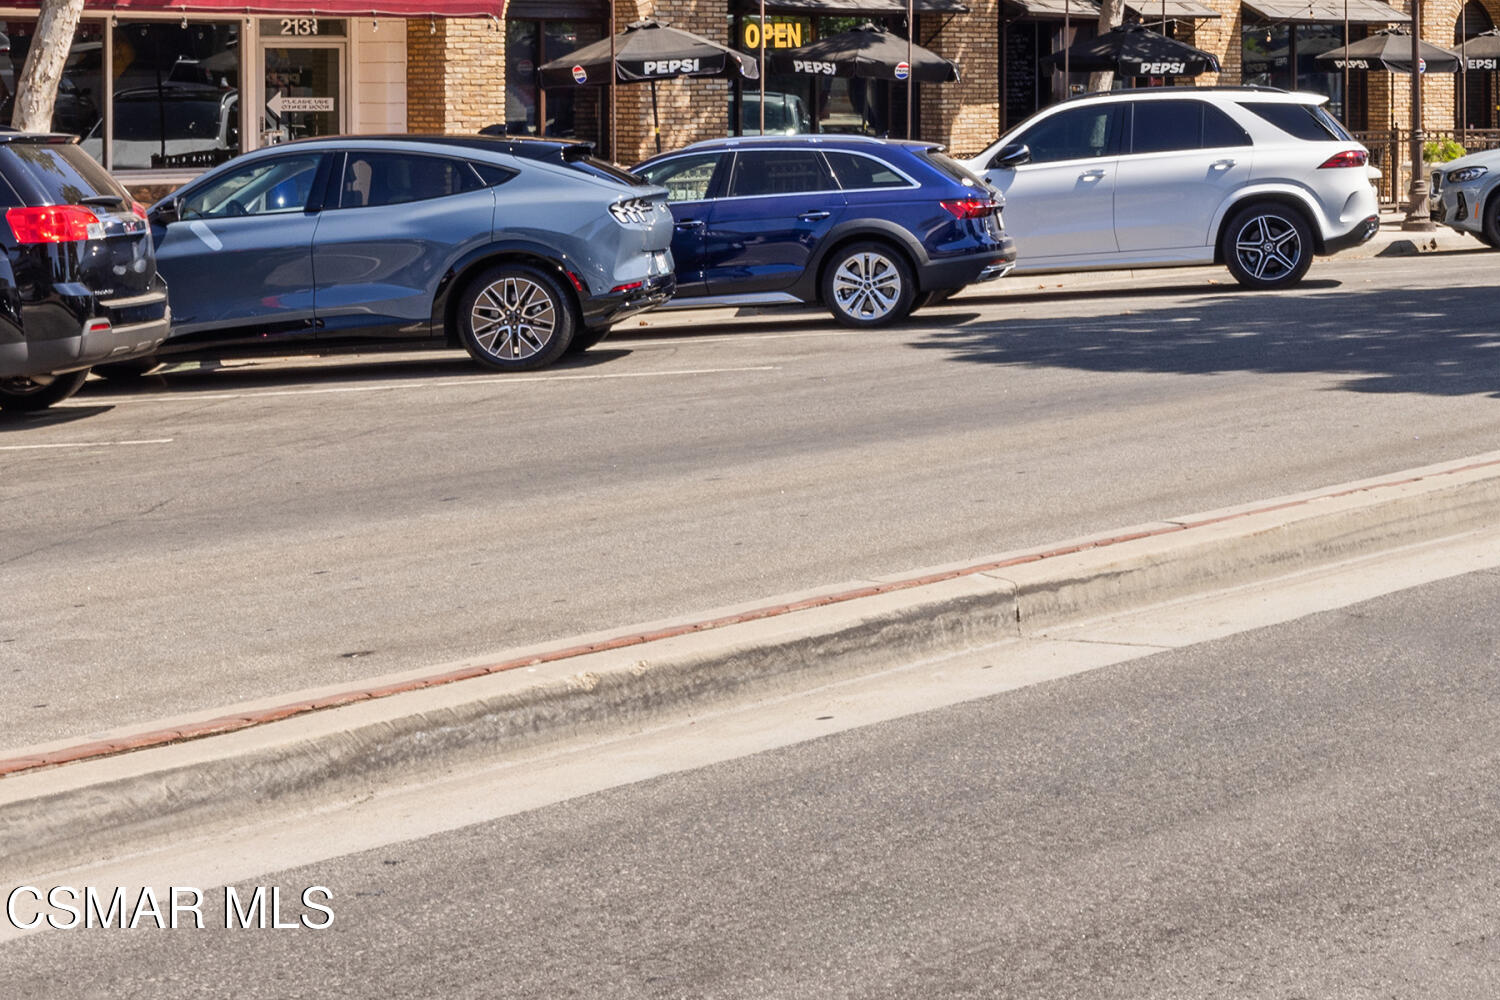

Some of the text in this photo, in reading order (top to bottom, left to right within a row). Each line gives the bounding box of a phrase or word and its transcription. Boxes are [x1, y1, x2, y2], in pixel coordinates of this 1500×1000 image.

[745, 23, 802, 49] OPEN
[643, 59, 698, 75] PEPSI
[793, 60, 836, 75] PEPSI
[1140, 62, 1185, 74] PEPSI
[1467, 58, 1497, 69] EPSI
